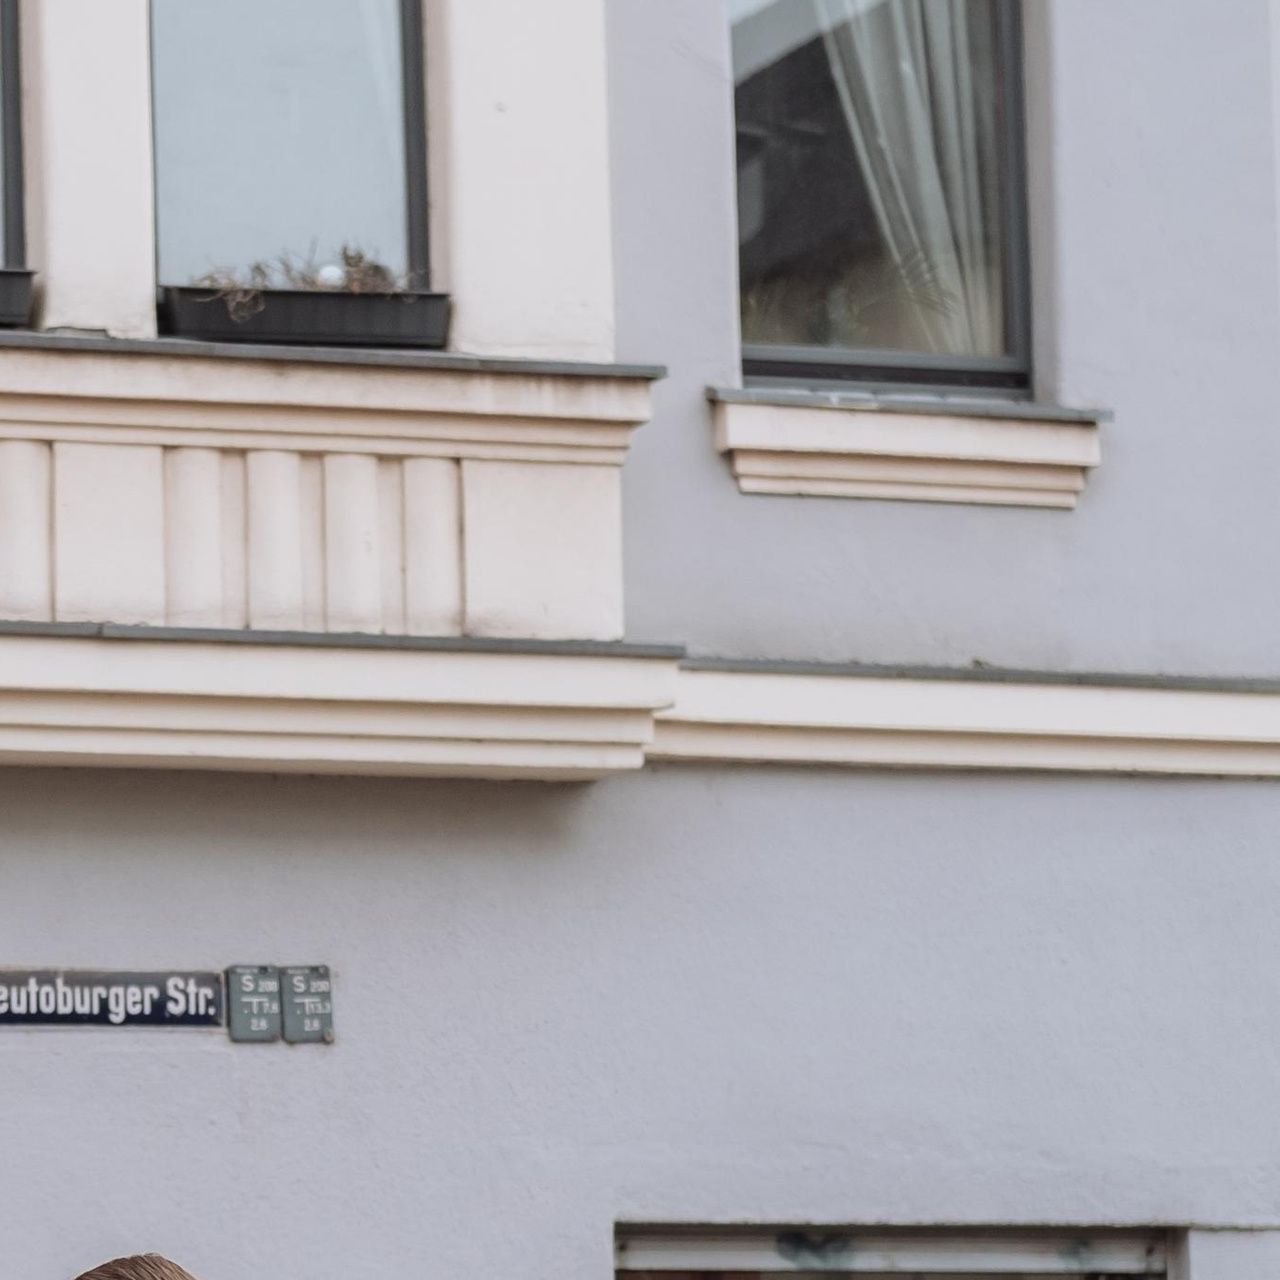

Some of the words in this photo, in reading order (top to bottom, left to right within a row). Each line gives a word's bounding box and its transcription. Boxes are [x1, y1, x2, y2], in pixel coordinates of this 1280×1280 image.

[241, 975, 255, 992] S
[293, 976, 306, 993] S
[166, 976, 216, 1017] Str.
